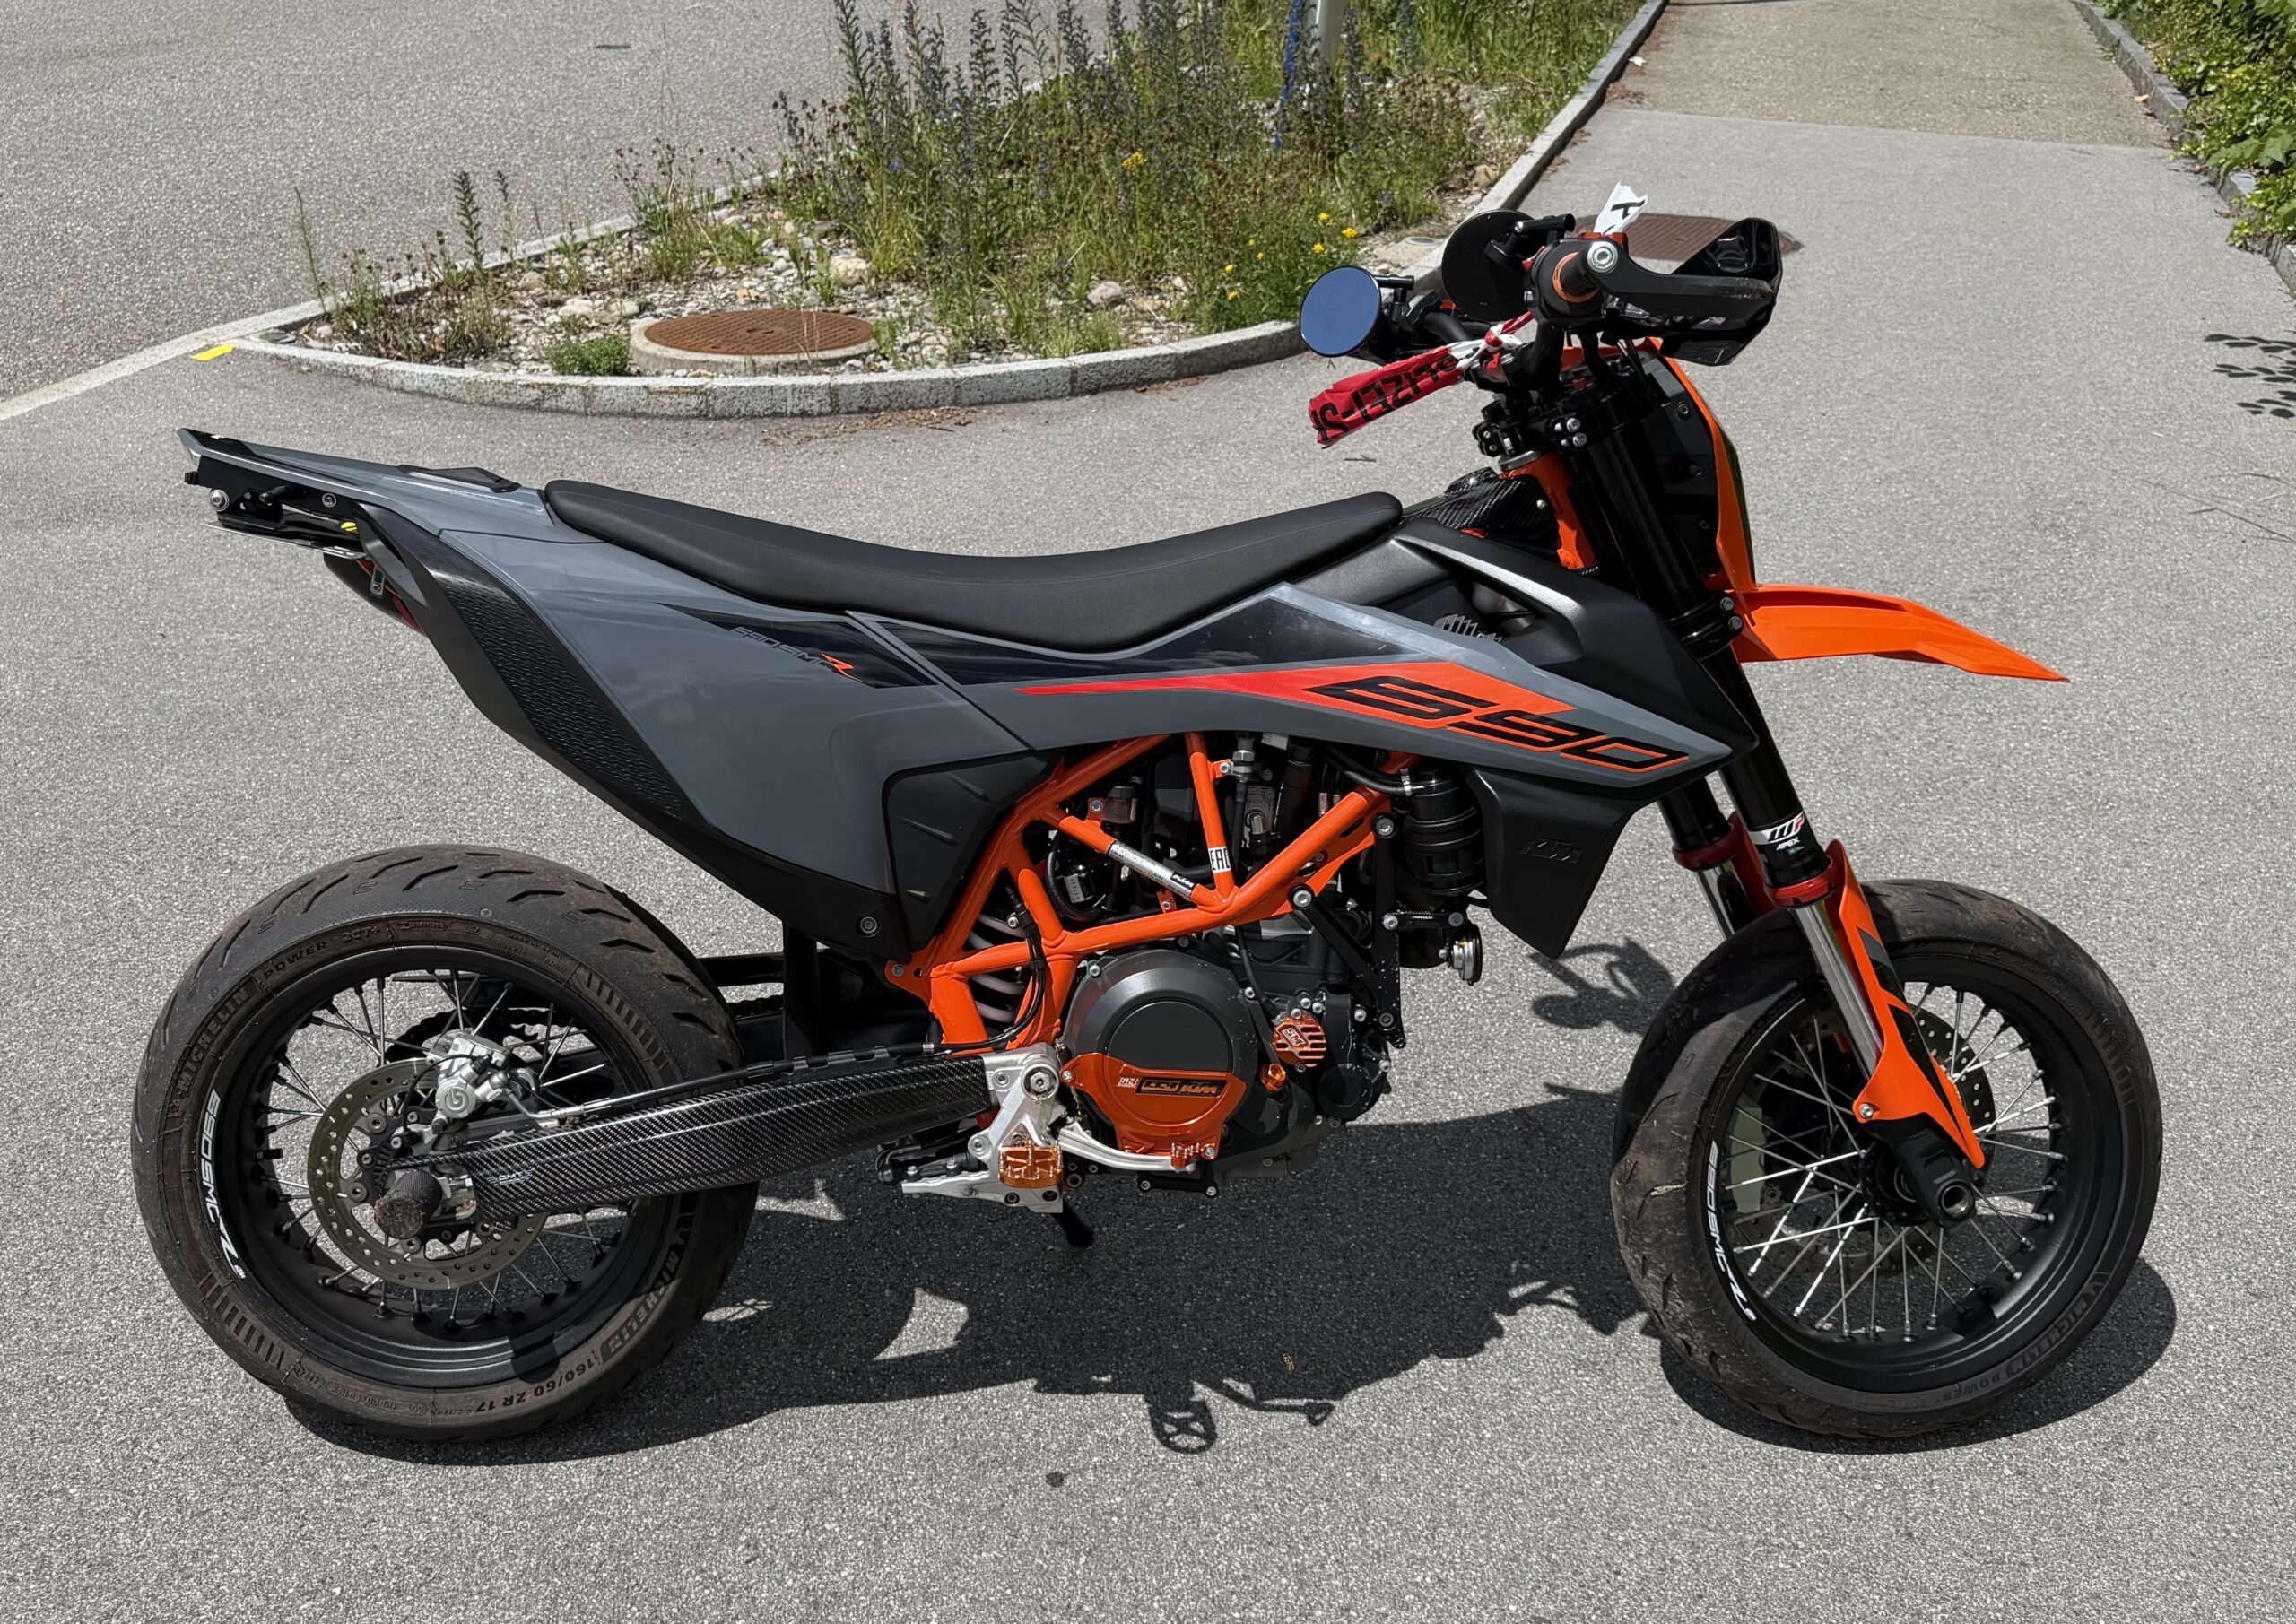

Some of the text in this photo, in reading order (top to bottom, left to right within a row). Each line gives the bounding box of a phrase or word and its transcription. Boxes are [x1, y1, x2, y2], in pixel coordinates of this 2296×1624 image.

[1305, 675, 1691, 772] 690
[1776, 836, 1801, 852] APEX
[1172, 873, 1195, 889] KTM
[264, 941, 328, 980] POWER
[178, 988, 250, 1093] MICHELIN
[609, 1250, 680, 1353] MICHELIN
[2010, 1297, 2088, 1373] MICHELIN
[535, 1358, 595, 1397] 160/60
[1943, 1373, 2000, 1402] POWER
[475, 1400, 496, 1413] 17
[502, 1391, 526, 1407] ZR
